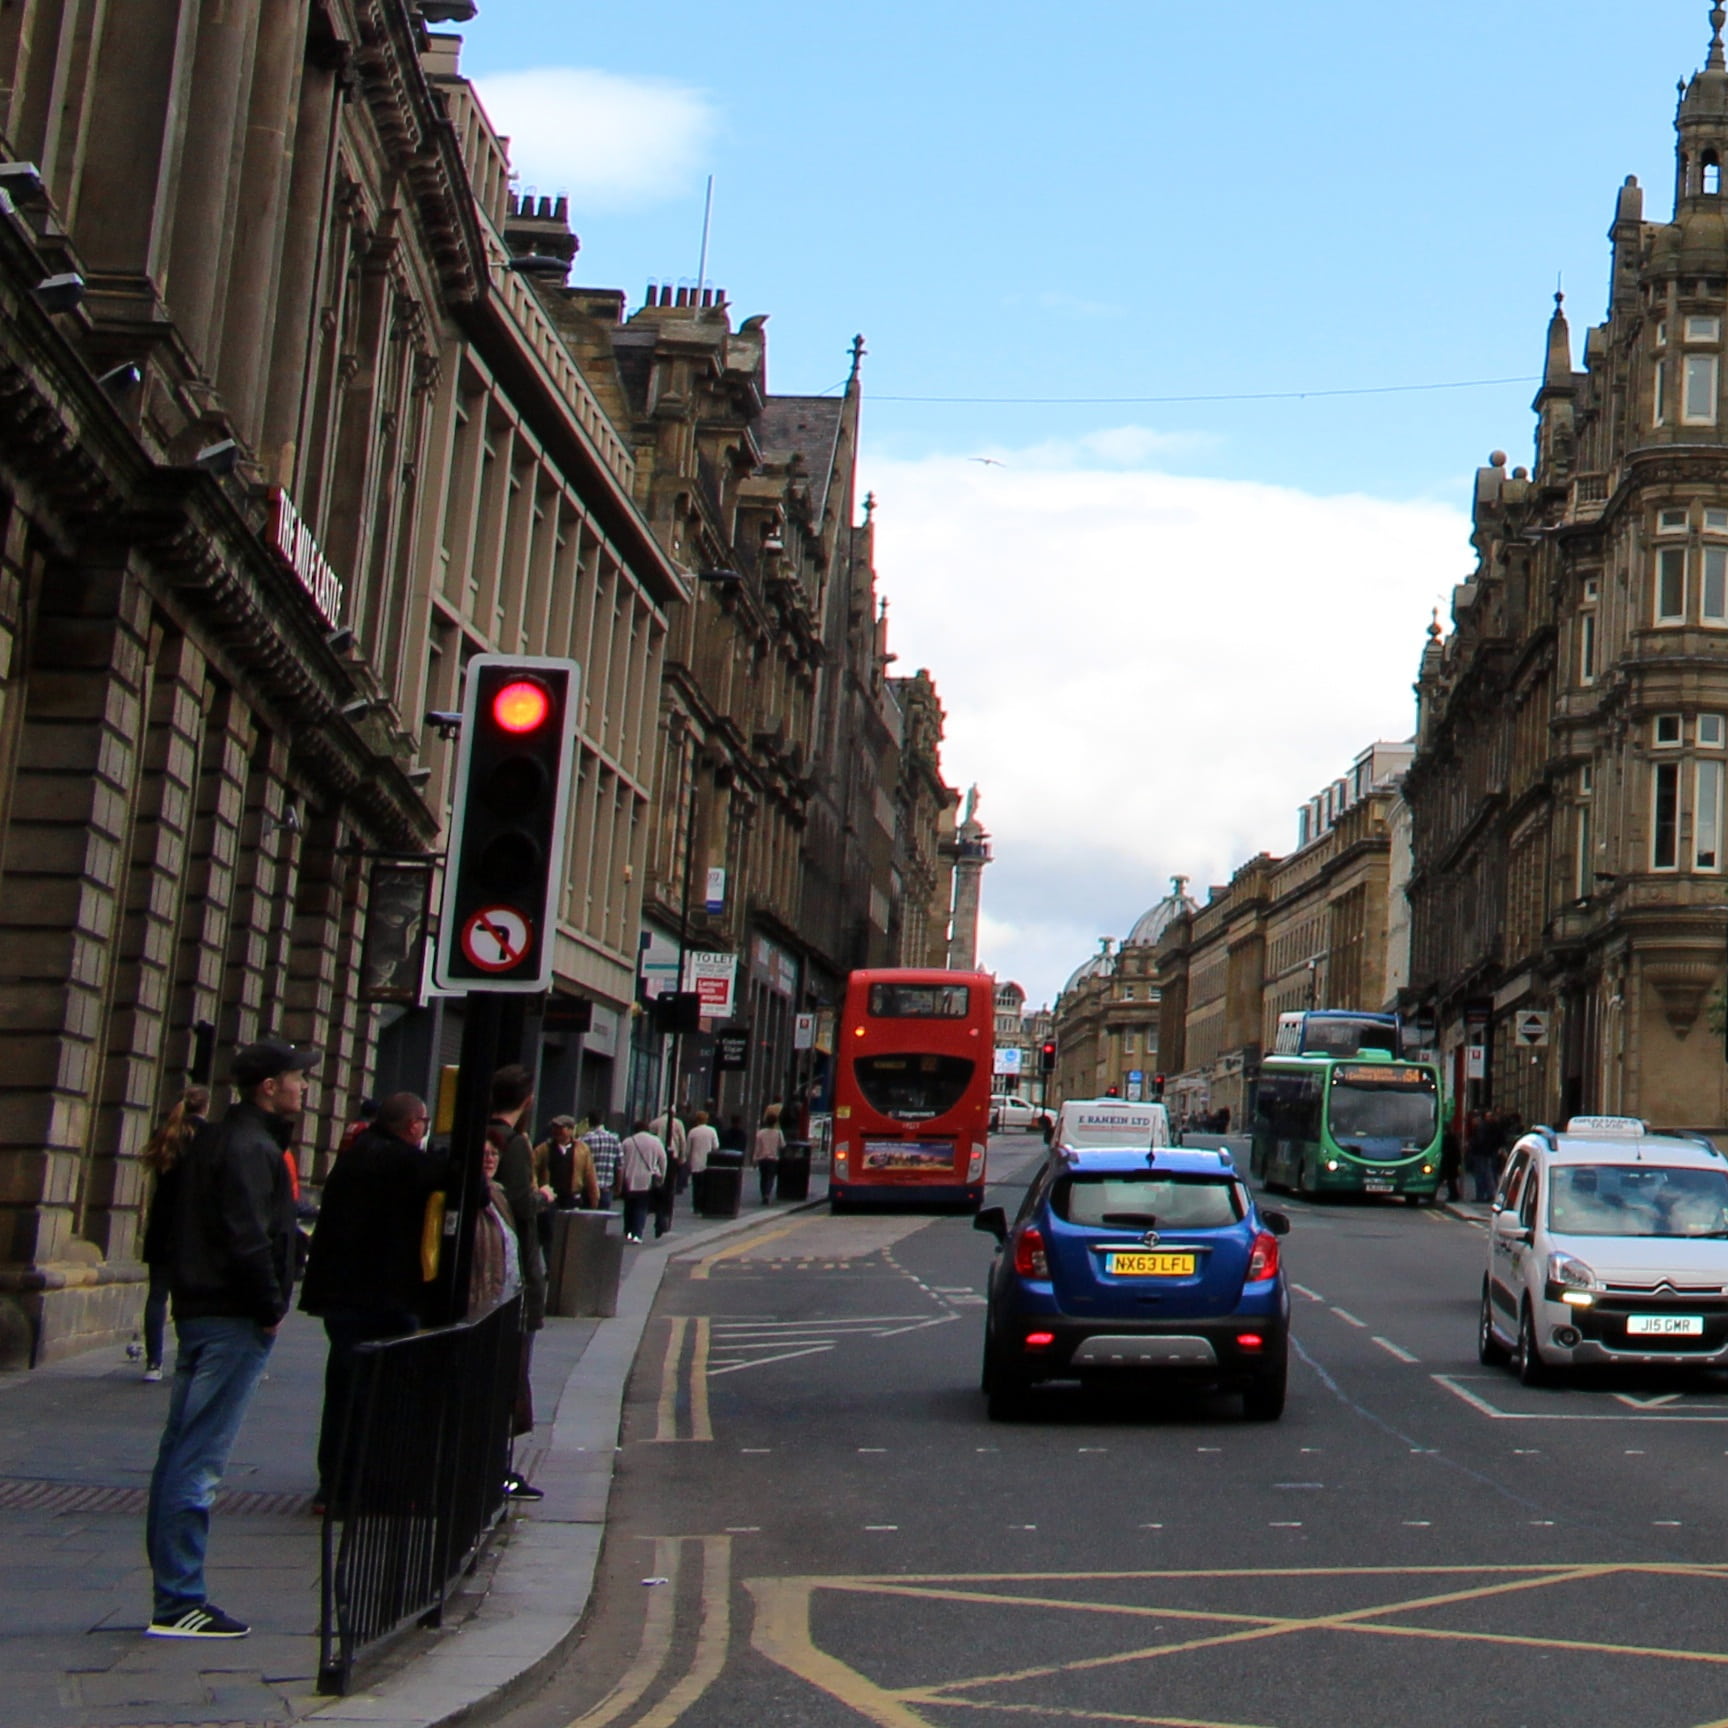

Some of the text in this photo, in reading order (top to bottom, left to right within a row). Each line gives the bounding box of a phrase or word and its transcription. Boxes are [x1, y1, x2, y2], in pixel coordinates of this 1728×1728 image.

[277, 487, 343, 631] THE MILE CASTLE
[696, 953, 733, 964] TO LET
[1088, 1116, 1128, 1124] RANKIN
[1132, 1118, 1150, 1126] LTD
[1115, 1256, 1191, 1271] NX63 LFL
[1641, 1319, 1690, 1332] J15 GMR
